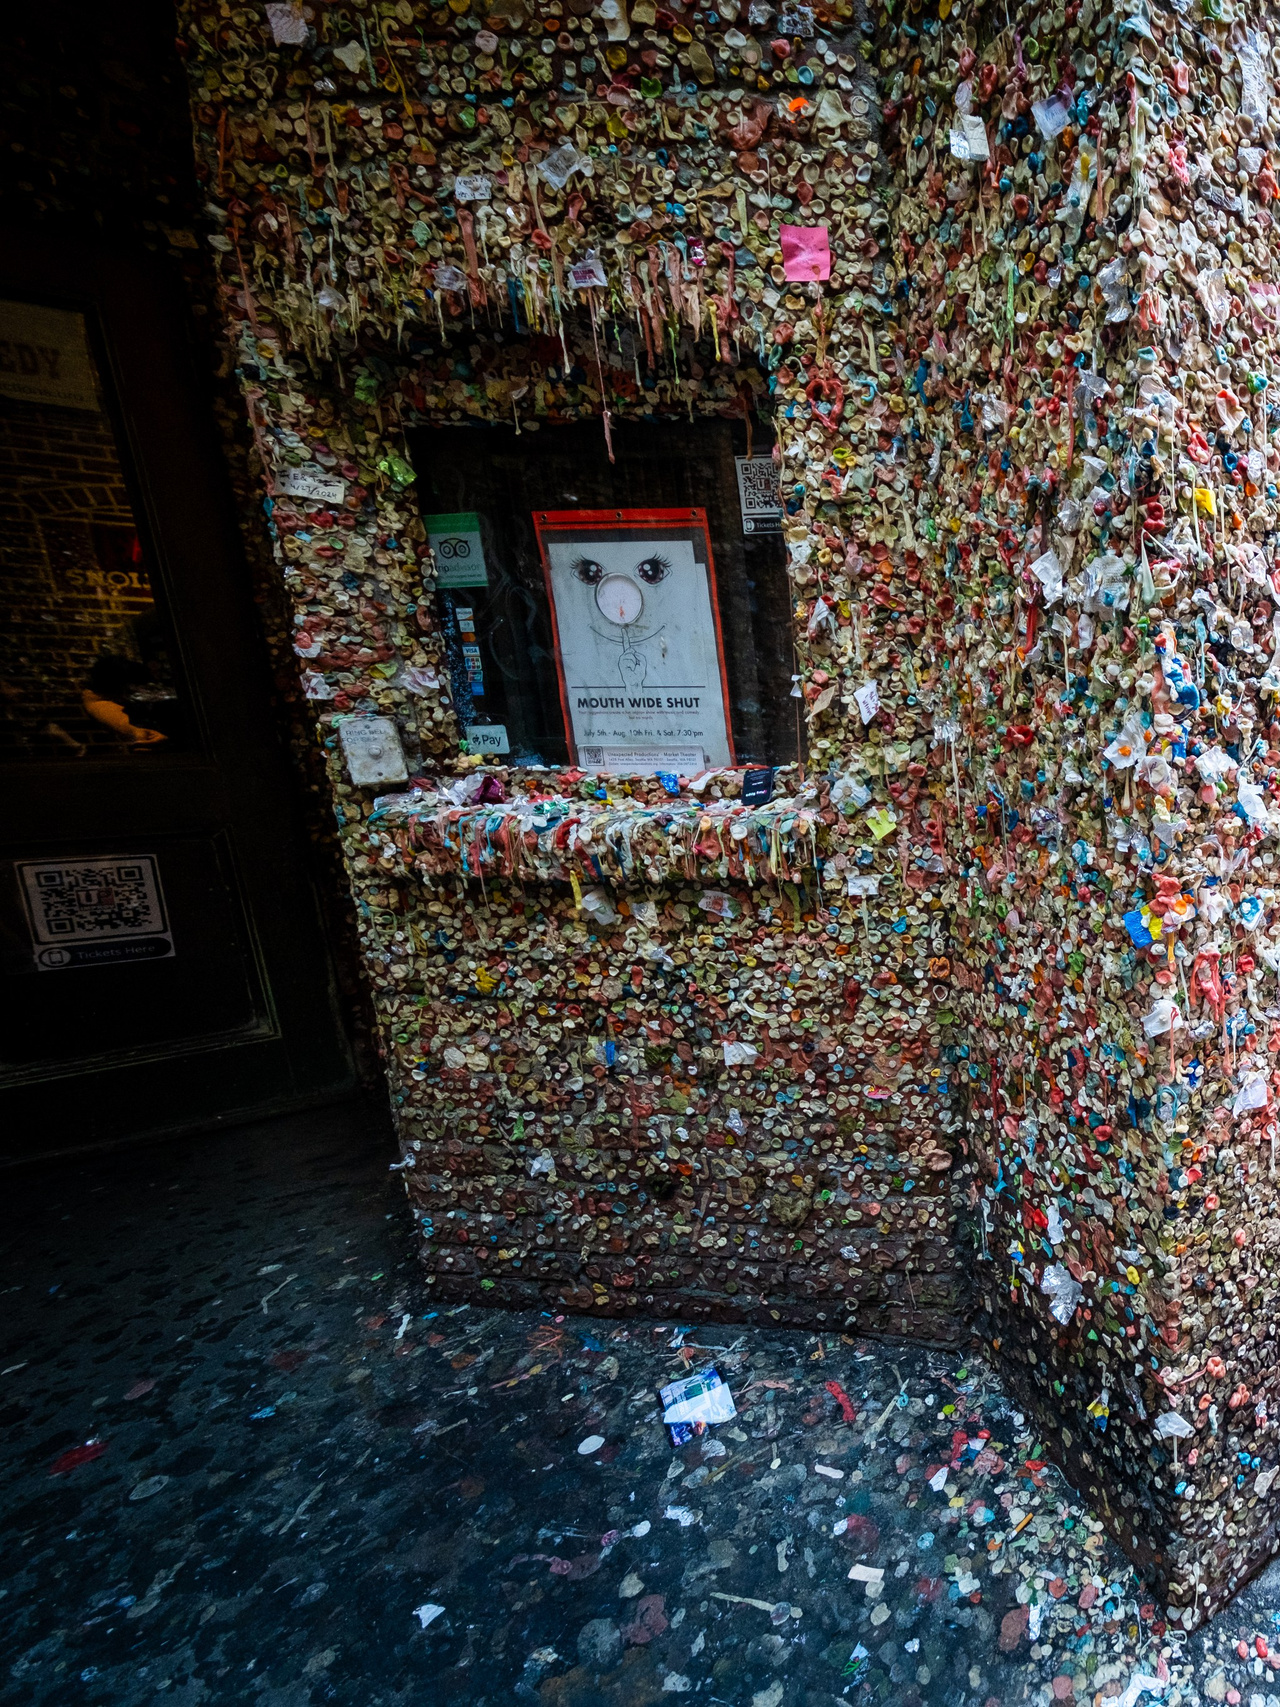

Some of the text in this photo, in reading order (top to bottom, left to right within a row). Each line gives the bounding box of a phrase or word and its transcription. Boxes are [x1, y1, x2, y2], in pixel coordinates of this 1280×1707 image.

[577, 697, 700, 709] MOUTH WIDE SHUT
[584, 729, 595, 738] July
[482, 734, 501, 747] Pay
[76, 945, 156, 959] Tickets Here
